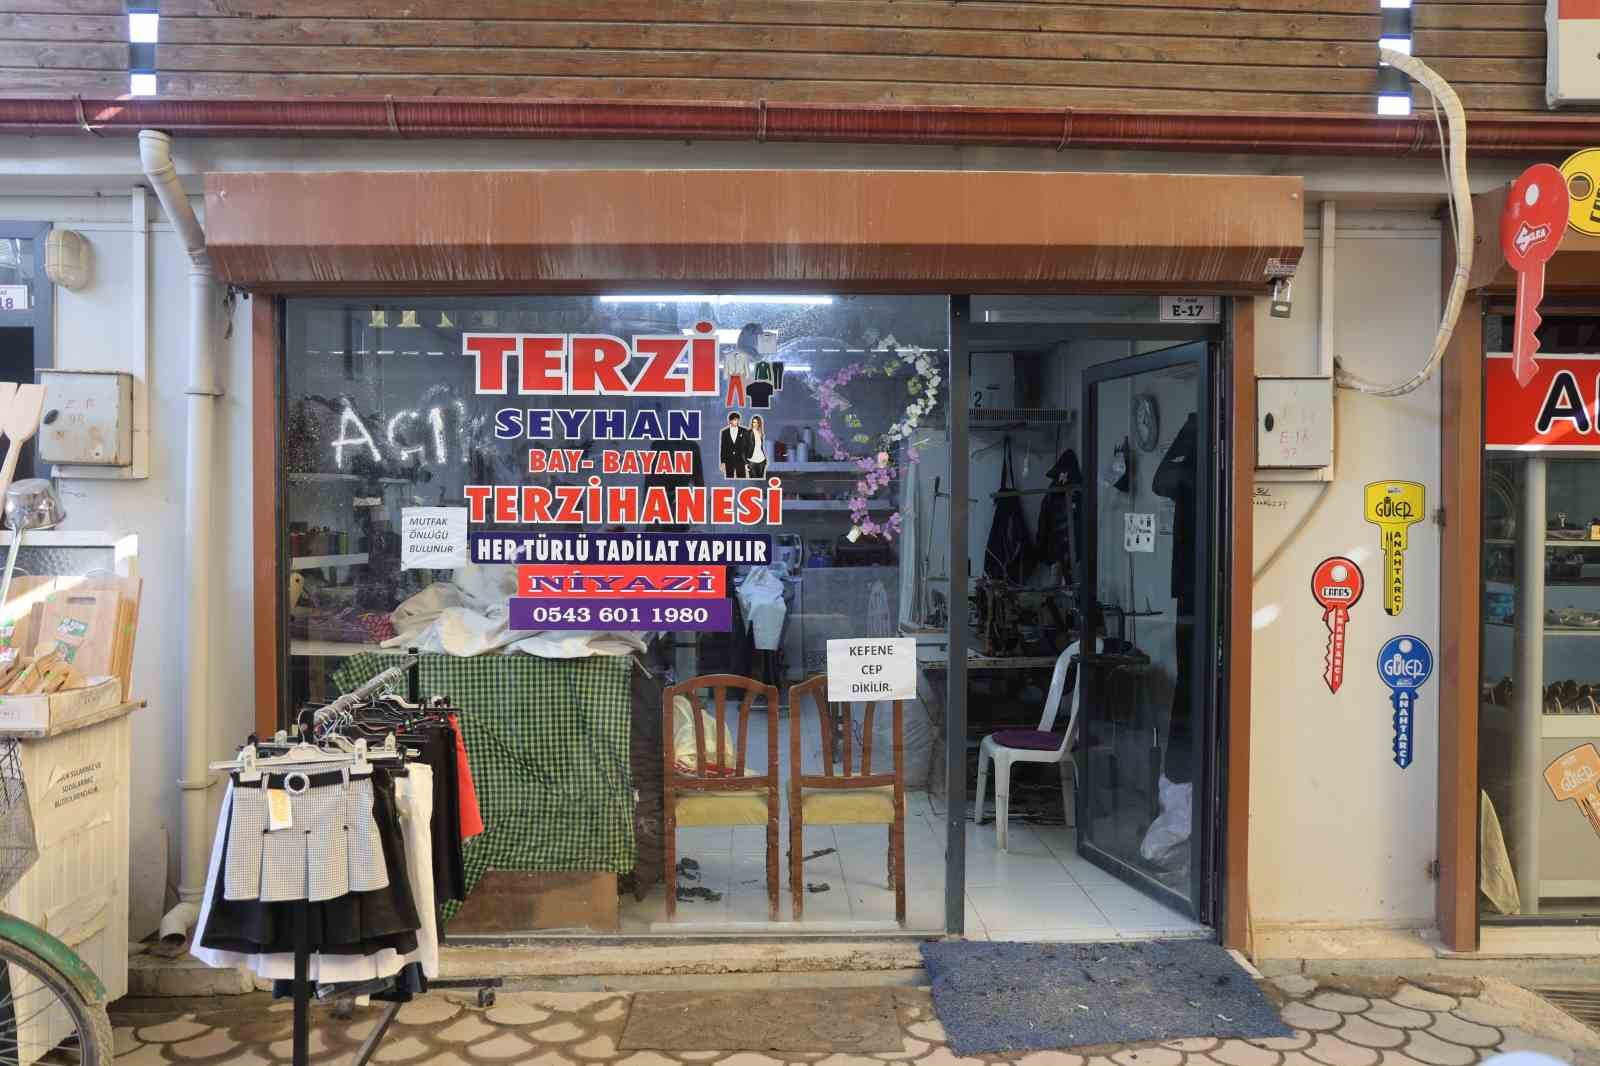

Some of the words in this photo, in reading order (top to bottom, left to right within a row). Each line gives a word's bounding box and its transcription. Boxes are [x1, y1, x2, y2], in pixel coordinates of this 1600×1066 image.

[1172, 304, 1204, 317] E-17
[462, 320, 720, 397] TERZİ
[1534, 369, 1600, 435] A
[495, 408, 702, 441] SEYHAN
[528, 448, 594, 474] BAY-
[602, 449, 694, 475] BAYAN
[464, 475, 783, 526] TERZİHANESİ
[1375, 496, 1414, 520] GÜLER
[409, 517, 448, 526] MUTFAK
[409, 545, 454, 553] BULUNUR
[477, 538, 515, 562] HER
[524, 533, 589, 562] TÜRLÜ
[596, 533, 680, 563] TADİLAT
[685, 540, 767, 563] YAPILIR
[528, 570, 716, 593] NİYAZİ
[1393, 531, 1402, 612] ANAHTARCI
[532, 606, 591, 623] 0543
[599, 607, 641, 623] 601
[652, 607, 709, 623] 1980
[849, 645, 894, 656] KEFENE
[861, 664, 882, 675] CEP
[1384, 653, 1426, 679] GÜLER
[1398, 691, 1409, 766] ANAHTARCI
